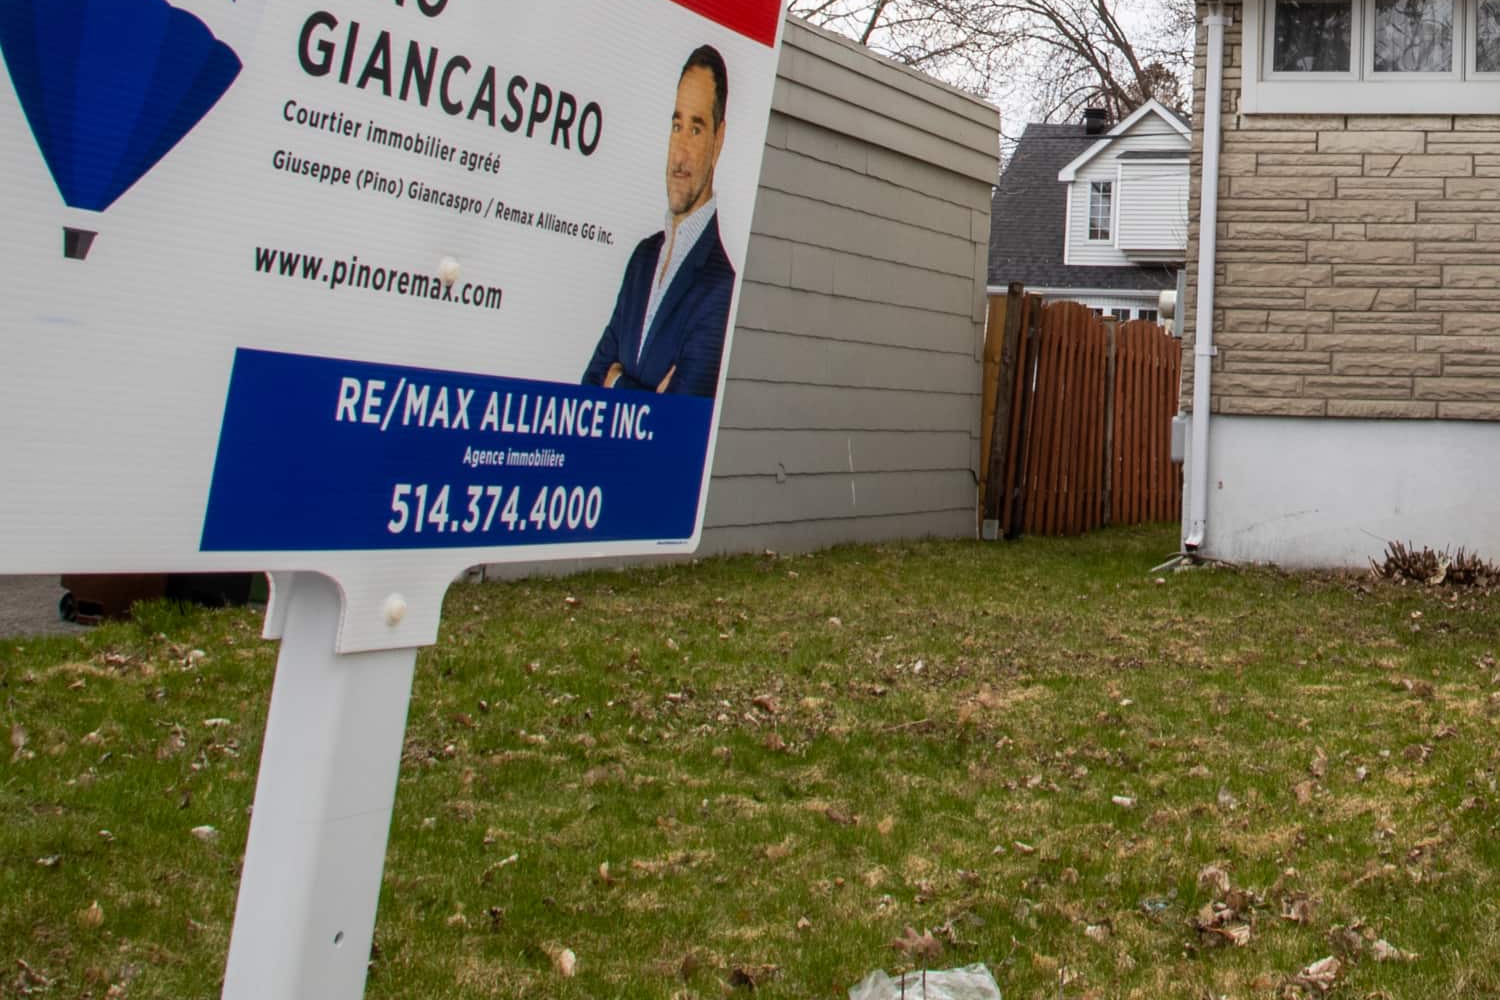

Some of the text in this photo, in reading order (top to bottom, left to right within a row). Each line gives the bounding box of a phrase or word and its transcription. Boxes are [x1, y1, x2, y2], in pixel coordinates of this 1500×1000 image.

[297, 11, 603, 157] GIANCASPRO
[283, 99, 501, 175] Courtier immobilier agréé
[272, 149, 352, 186] Giuseppe
[356, 168, 404, 199] (Pino)
[407, 181, 482, 215] Giancaspro
[495, 202, 533, 227] Remax
[536, 211, 579, 238] Alliance
[580, 223, 596, 241] GG
[597, 228, 615, 246] inc.
[254, 246, 503, 310] www.pinoremax.com
[335, 377, 654, 441] RE/MAX ALLIANCE INC.
[463, 446, 566, 468] Agence immobilière
[387, 484, 603, 534] 514.374.4000
